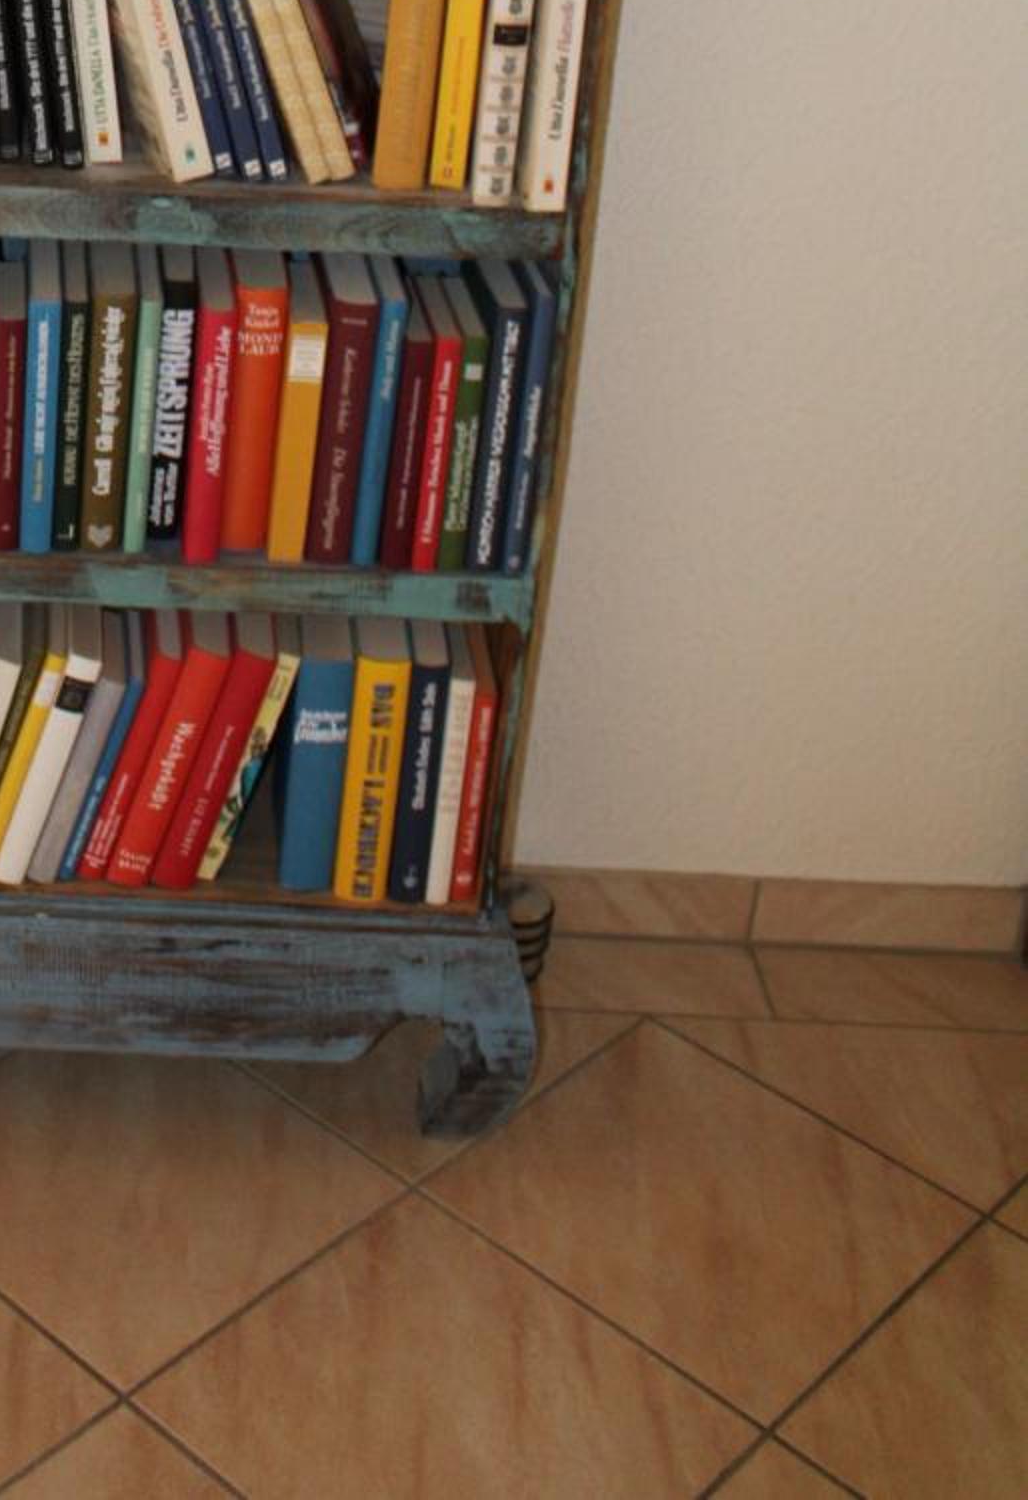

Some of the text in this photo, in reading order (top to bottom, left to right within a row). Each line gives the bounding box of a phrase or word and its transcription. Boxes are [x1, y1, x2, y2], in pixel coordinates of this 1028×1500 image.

[551, 57, 570, 113] Danella
[154, 309, 195, 458] ZEITSPRUNG
[370, 683, 396, 730] DAS
